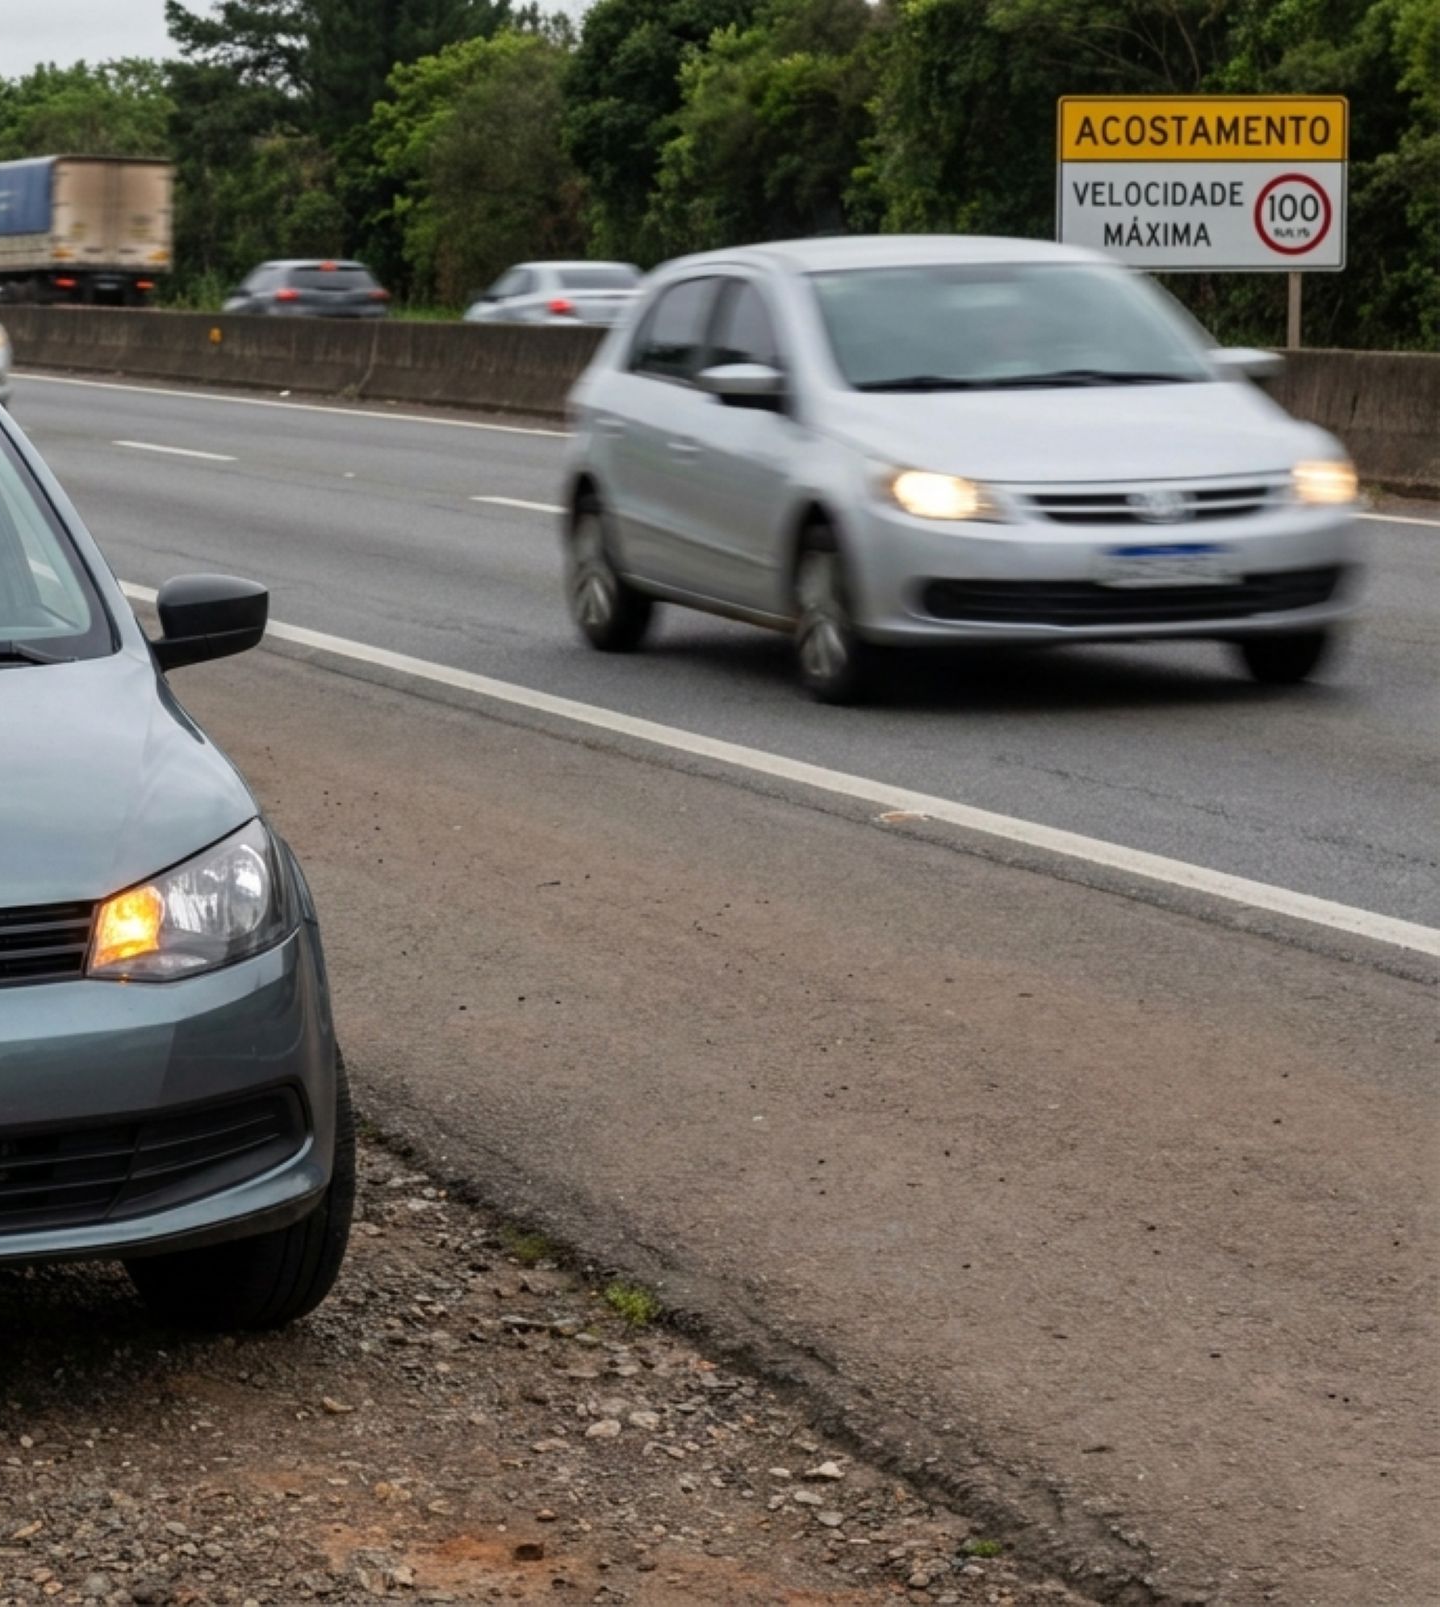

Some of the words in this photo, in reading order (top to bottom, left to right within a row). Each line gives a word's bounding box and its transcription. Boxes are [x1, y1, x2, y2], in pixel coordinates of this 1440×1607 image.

[1074, 115, 1331, 146] ACOSTAMENTO
[1072, 181, 1245, 208] VELOCIDADE
[1268, 193, 1319, 222] 100
[1103, 215, 1212, 247] MÁXIMA
